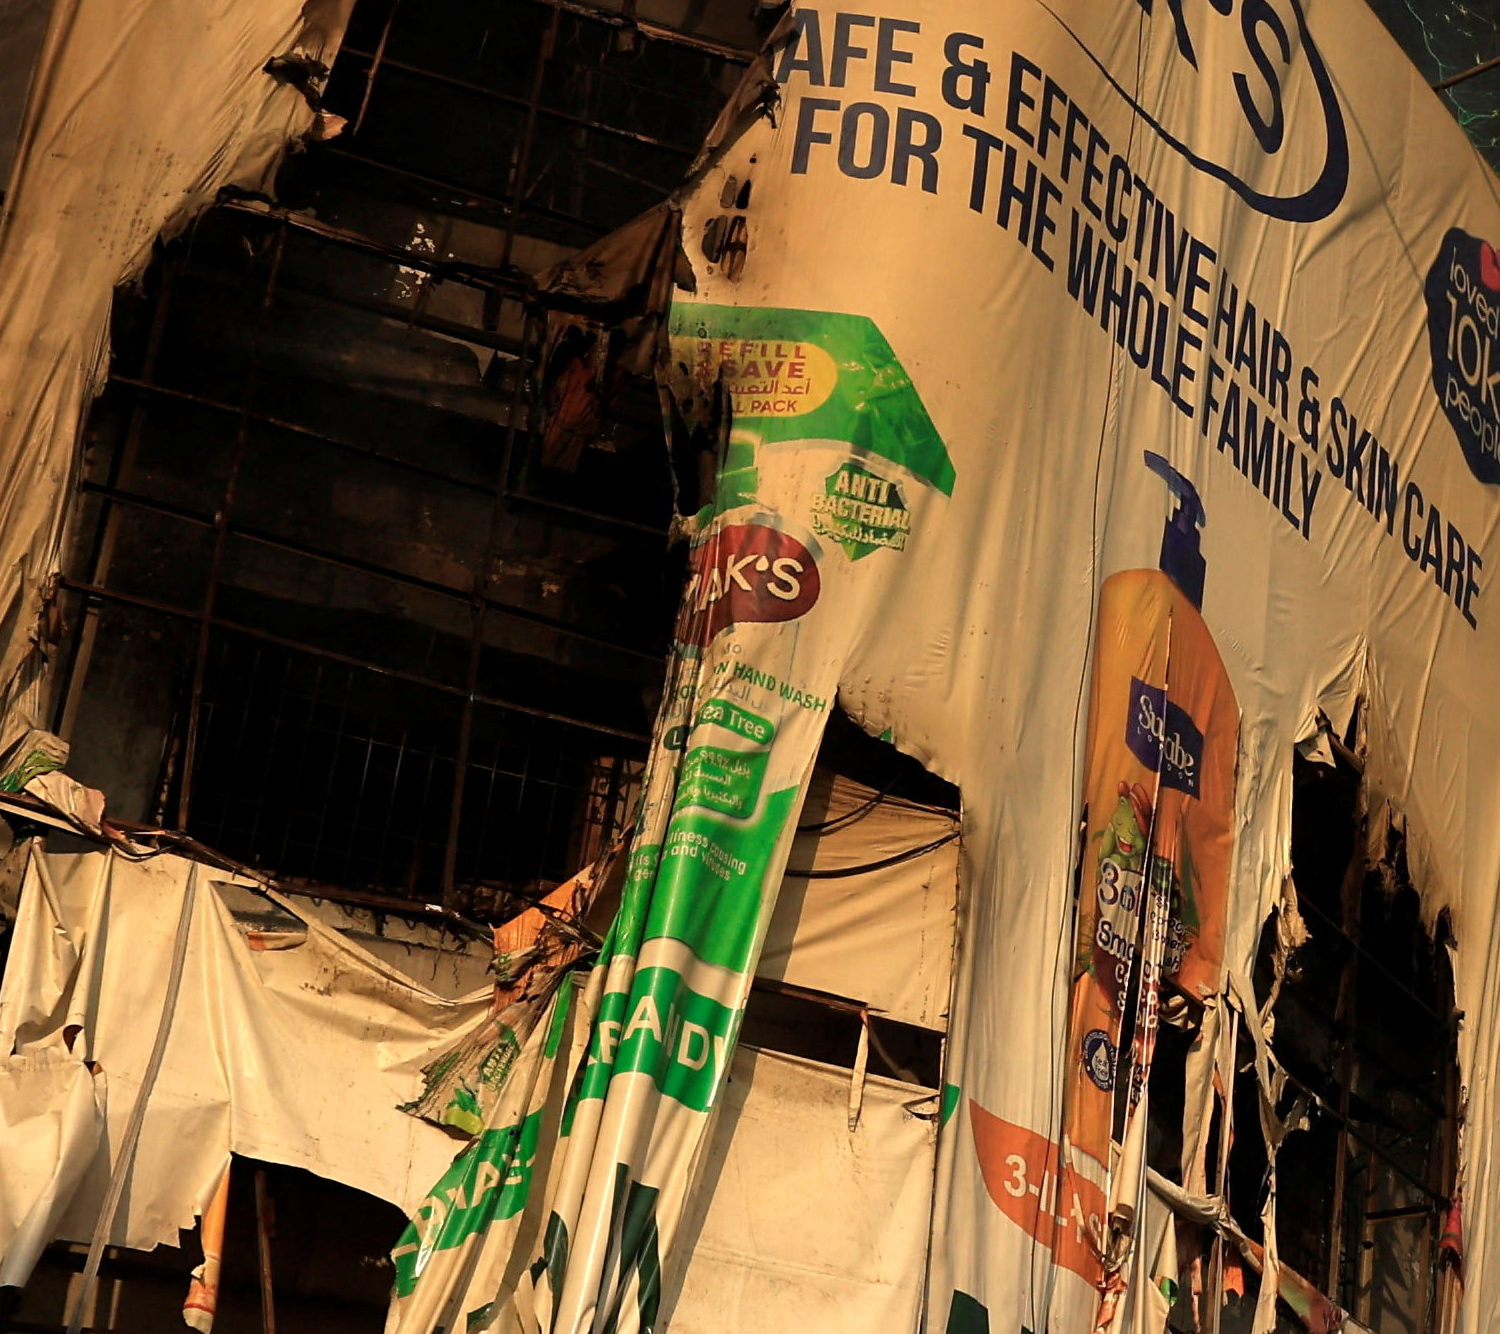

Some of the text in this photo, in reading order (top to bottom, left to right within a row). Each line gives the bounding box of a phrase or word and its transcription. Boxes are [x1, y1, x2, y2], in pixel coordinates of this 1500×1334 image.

[1449, 246, 1500, 343] loved
[776, 8, 1483, 631] AFE & EFFECTIVE HAIR & SKIN CARE
[790, 96, 1324, 543] FOR THE WHOLE FAMILY
[721, 359, 806, 380] SAVE
[750, 399, 799, 414] PACK
[835, 469, 891, 504] ANTI
[811, 492, 912, 533] BACTERIAL
[733, 661, 777, 692] HAND
[779, 681, 828, 713] WASH
[729, 709, 766, 741] Tree
[670, 843, 699, 857] and
